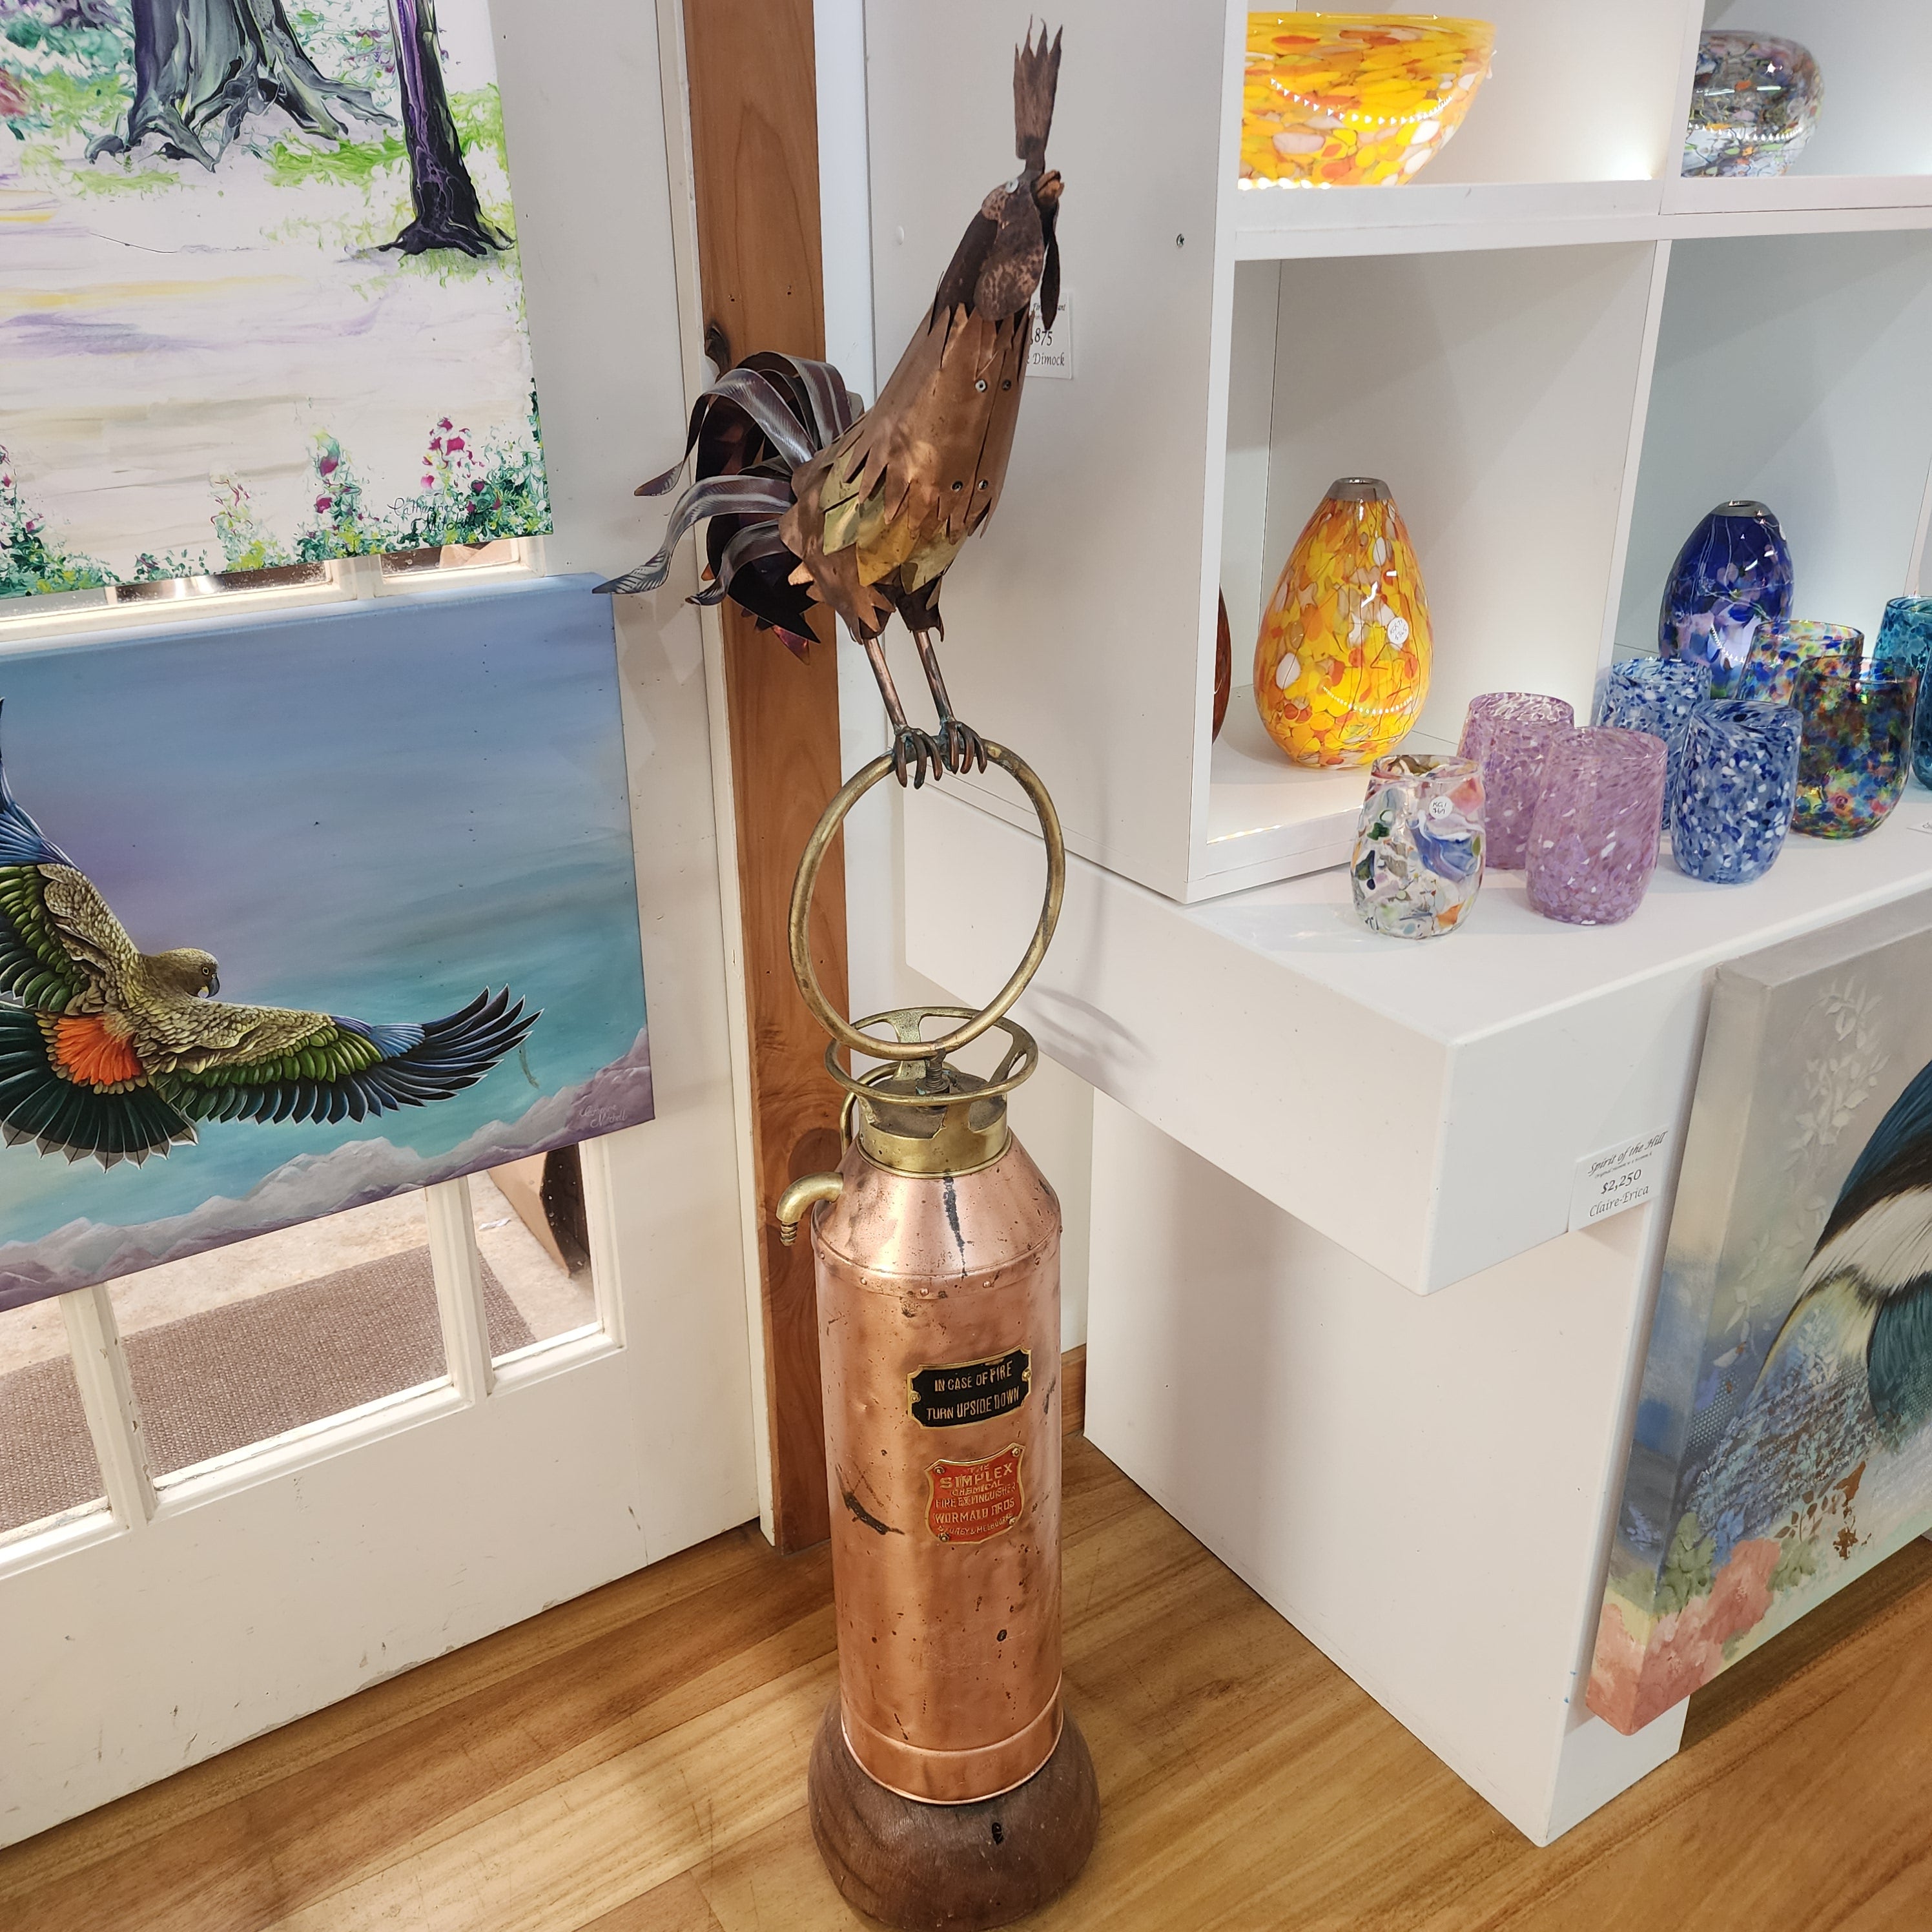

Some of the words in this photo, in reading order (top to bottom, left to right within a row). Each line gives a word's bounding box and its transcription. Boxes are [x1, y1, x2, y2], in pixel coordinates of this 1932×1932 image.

[1033, 352, 1064, 366] Dimock
[1587, 1154, 1617, 1177] Spirit
[1617, 1146, 1631, 1165] of
[1628, 1142, 1644, 1157] the
[1644, 1130, 1669, 1150] Hill
[1601, 1169, 1642, 1195] $2,250
[1589, 1186, 1649, 1217] Claire-Erica
[934, 1378, 945, 1392] IN
[947, 1376, 972, 1391] CASE
[976, 1372, 989, 1386] OF
[990, 1360, 1013, 1383] FIRE
[926, 1406, 954, 1421] TURN
[956, 1396, 992, 1419] UPSIDE
[994, 1386, 1020, 1410] DOWN
[940, 1463, 1013, 1489] SIMPLEX
[951, 1479, 1003, 1496] CHEMICAL
[936, 1498, 956, 1508] FIRE
[958, 1482, 1016, 1506] EXTINGUISHER
[933, 1508, 989, 1524] WORMALD
